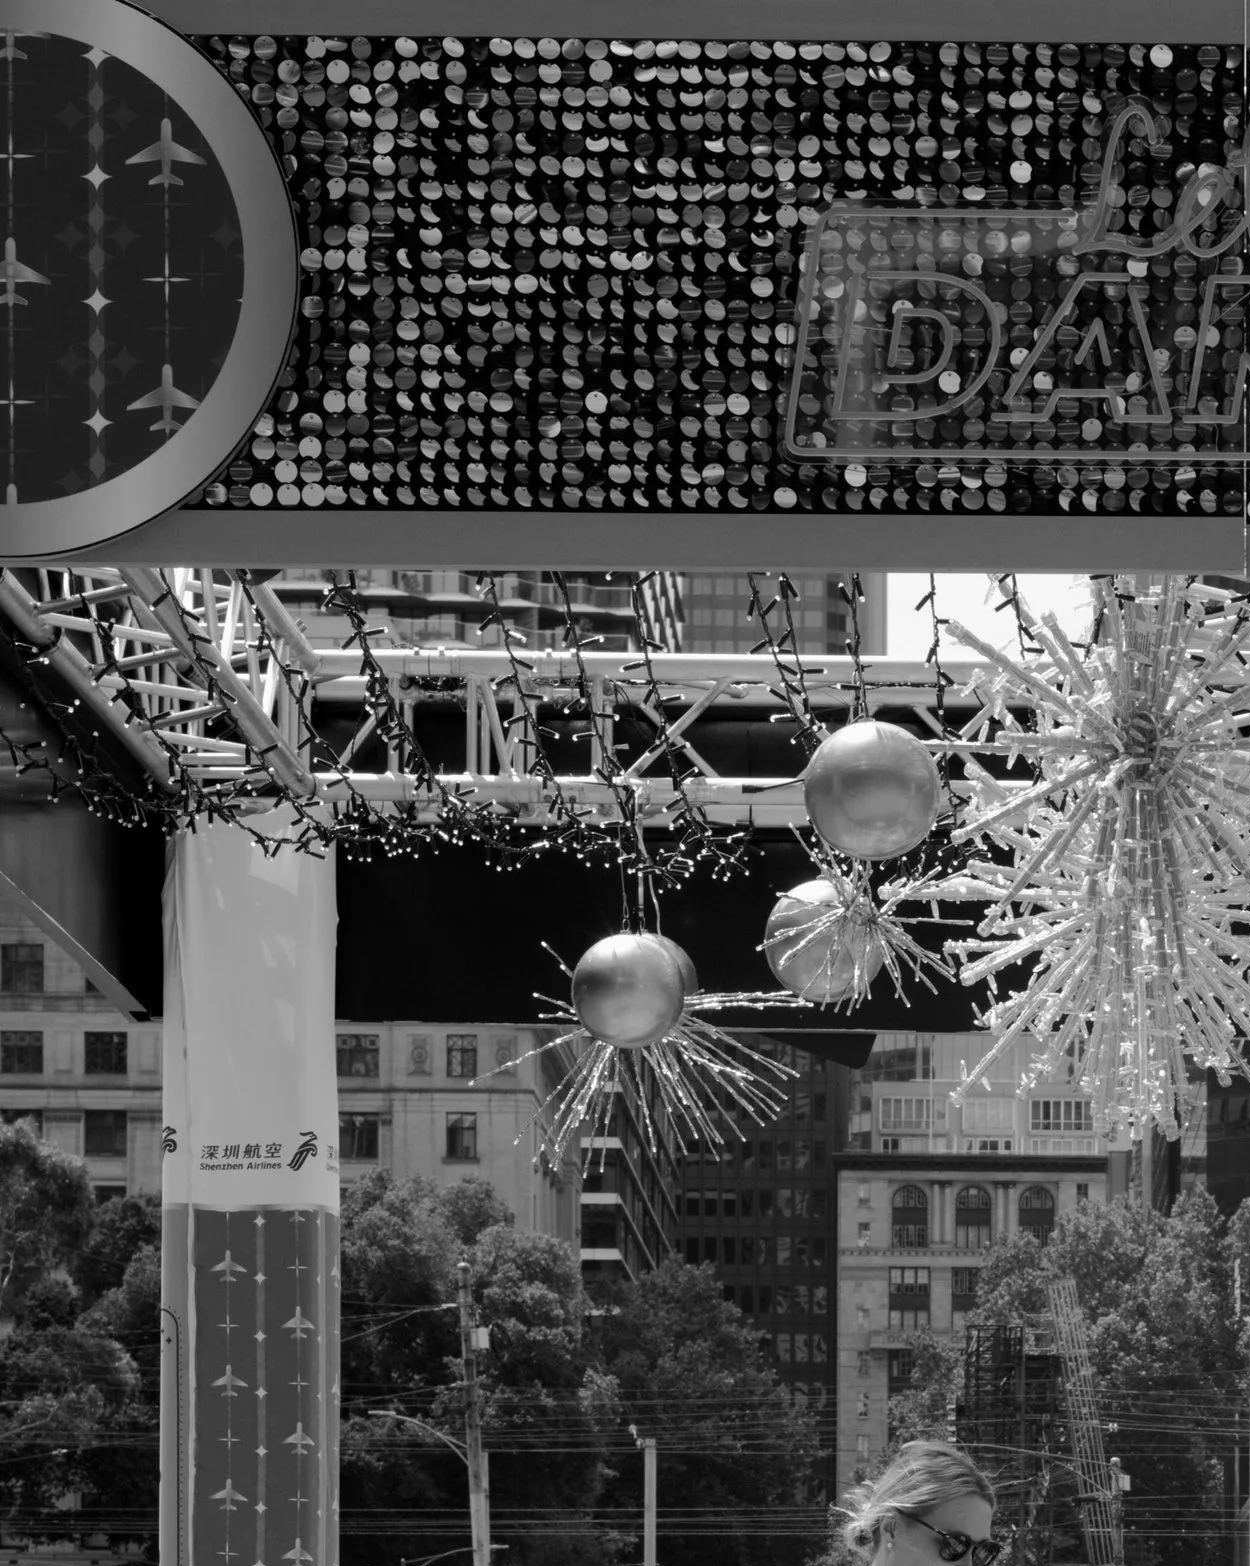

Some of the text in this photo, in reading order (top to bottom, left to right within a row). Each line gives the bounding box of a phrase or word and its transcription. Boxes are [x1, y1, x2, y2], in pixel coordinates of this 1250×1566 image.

[200, 1142, 282, 1160] 深圳航空
[199, 1161, 282, 1171] Shenzhen Airlines
